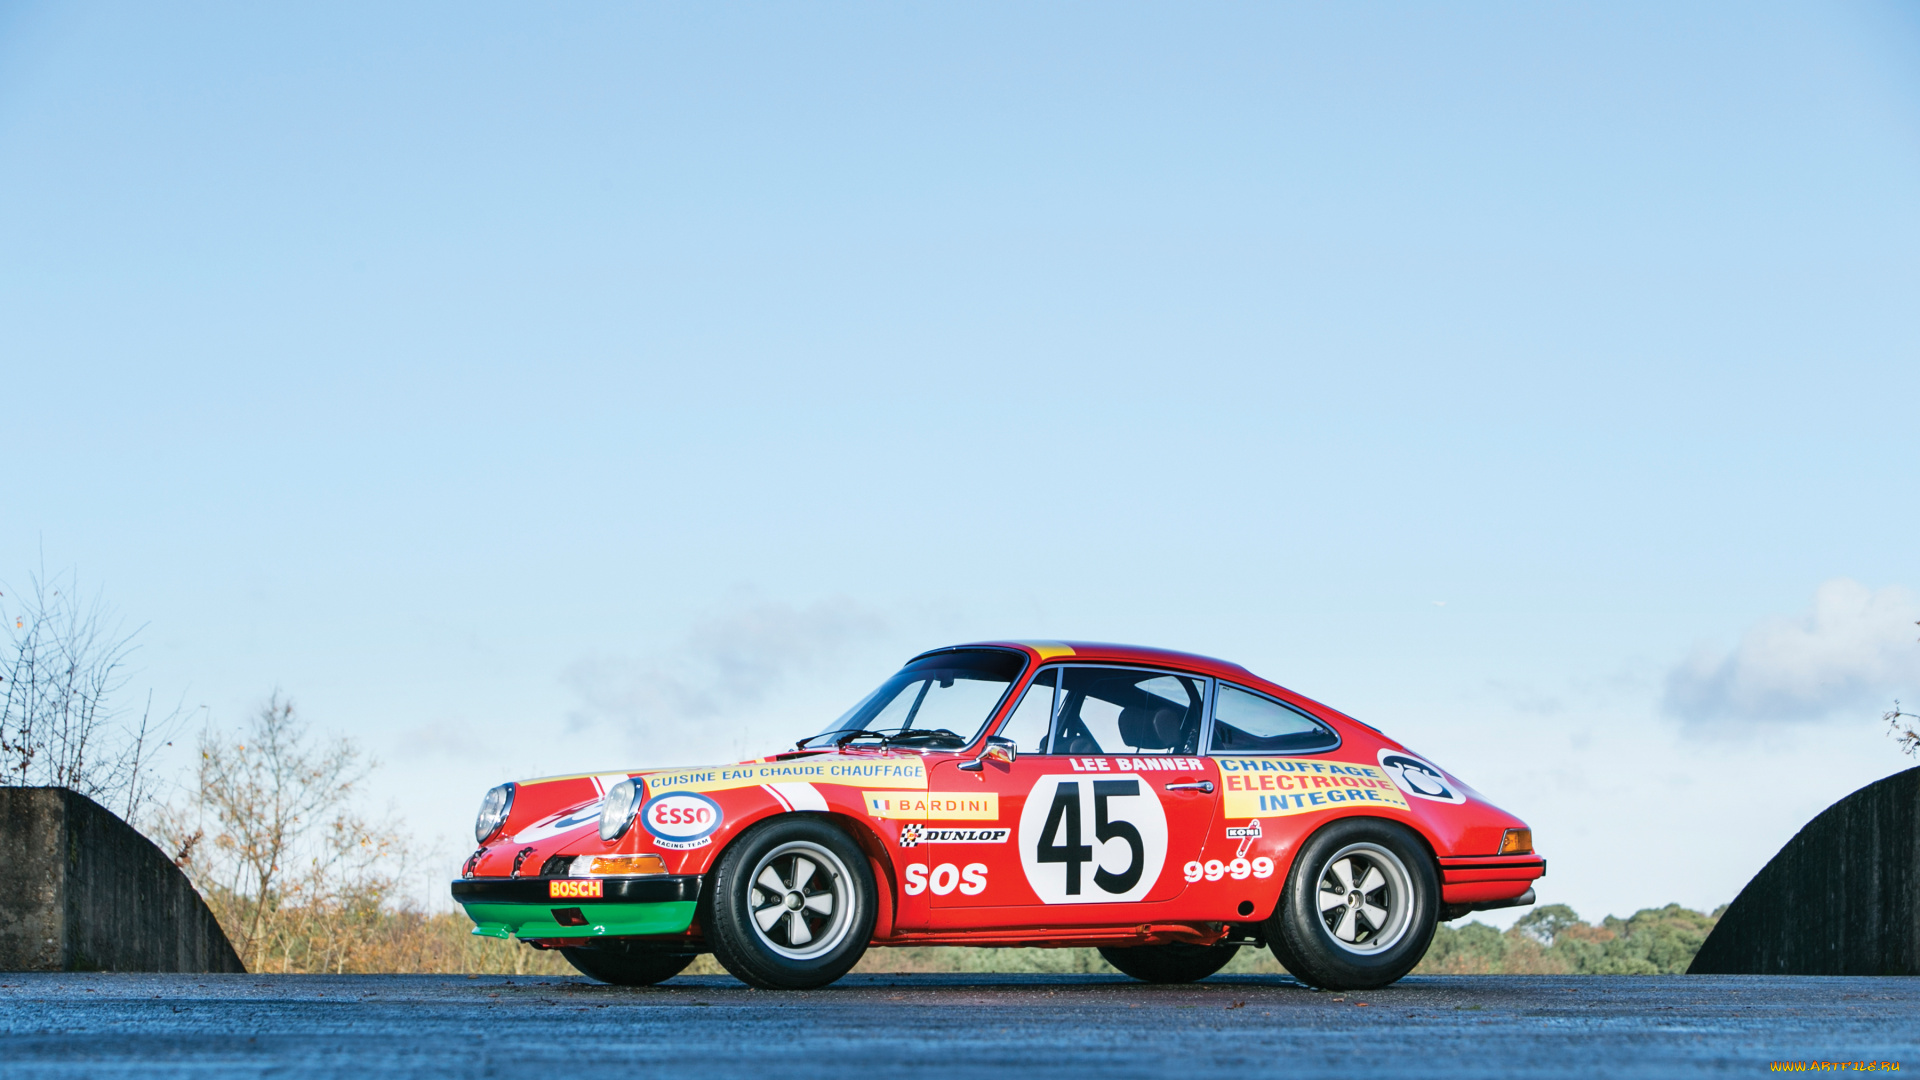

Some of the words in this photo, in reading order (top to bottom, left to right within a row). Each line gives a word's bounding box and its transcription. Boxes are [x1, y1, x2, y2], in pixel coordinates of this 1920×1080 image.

[1069, 758, 1111, 772] LEE
[1118, 757, 1205, 771] BANNER
[1219, 759, 1379, 778] CHAUFFAGE
[651, 772, 716, 788] CUISINE
[722, 769, 753, 780] EAU
[760, 766, 825, 777] CHAUDE
[830, 765, 923, 777] CHAUFFAGE
[1226, 775, 1394, 791] ELECTRIQUE
[899, 800, 988, 811] BARDINI
[656, 839, 684, 849] RACING
[687, 838, 709, 848] TEAM
[924, 830, 1006, 841] DUNLOP
[1037, 779, 1145, 895] 45
[904, 862, 988, 896] SOS
[550, 881, 601, 897] BOSCH
